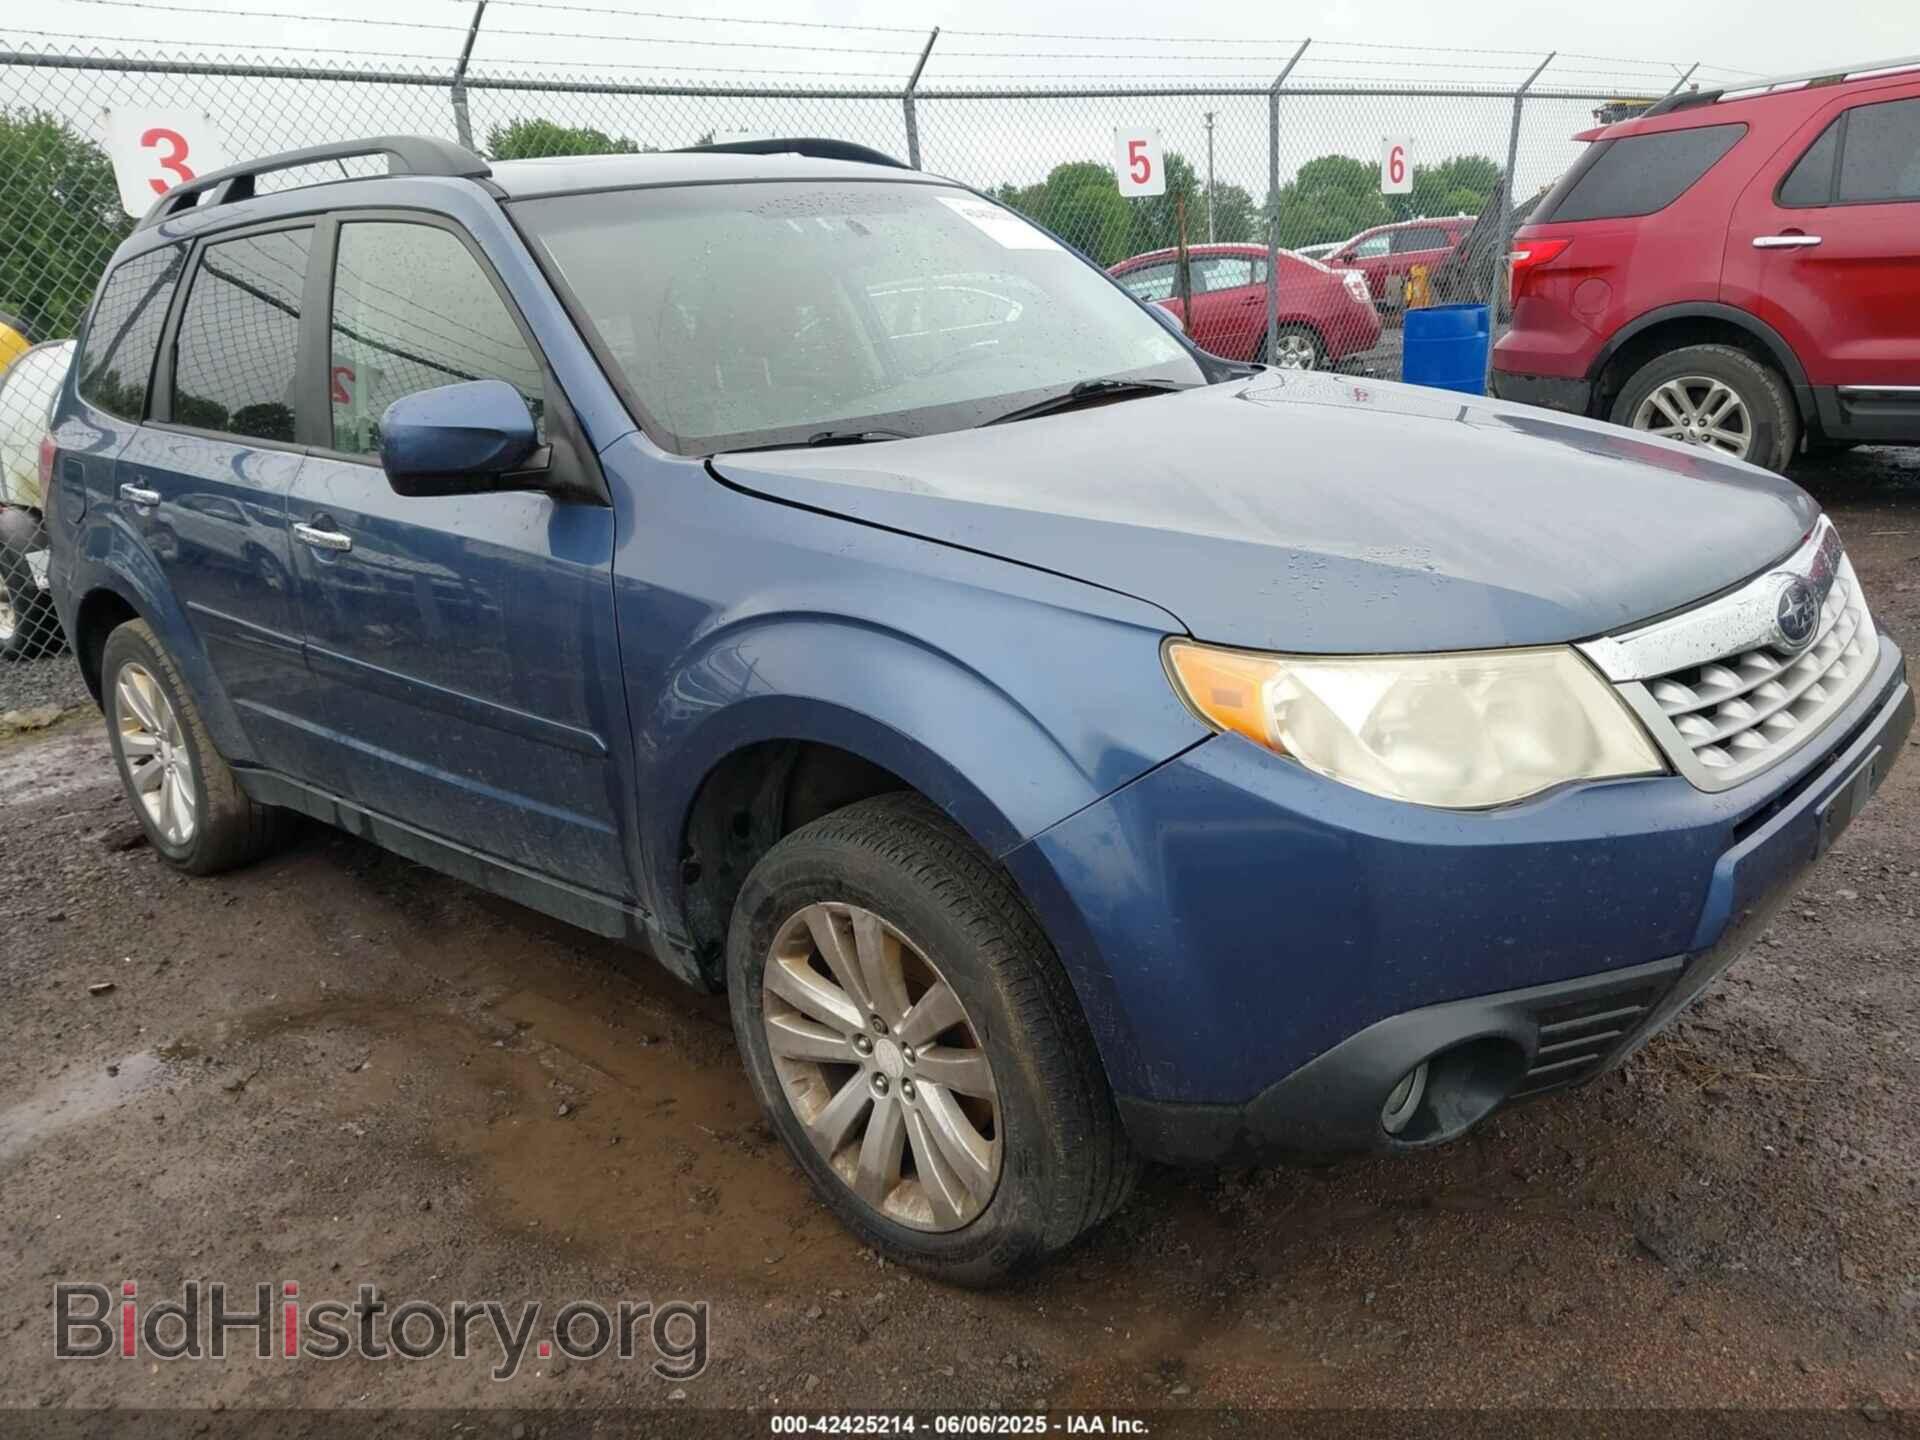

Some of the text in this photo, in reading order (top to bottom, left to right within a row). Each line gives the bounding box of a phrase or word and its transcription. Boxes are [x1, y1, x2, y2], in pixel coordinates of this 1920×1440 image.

[140, 127, 195, 195] 3
[1128, 139, 1152, 185] 5
[1389, 145, 1405, 184] 6
